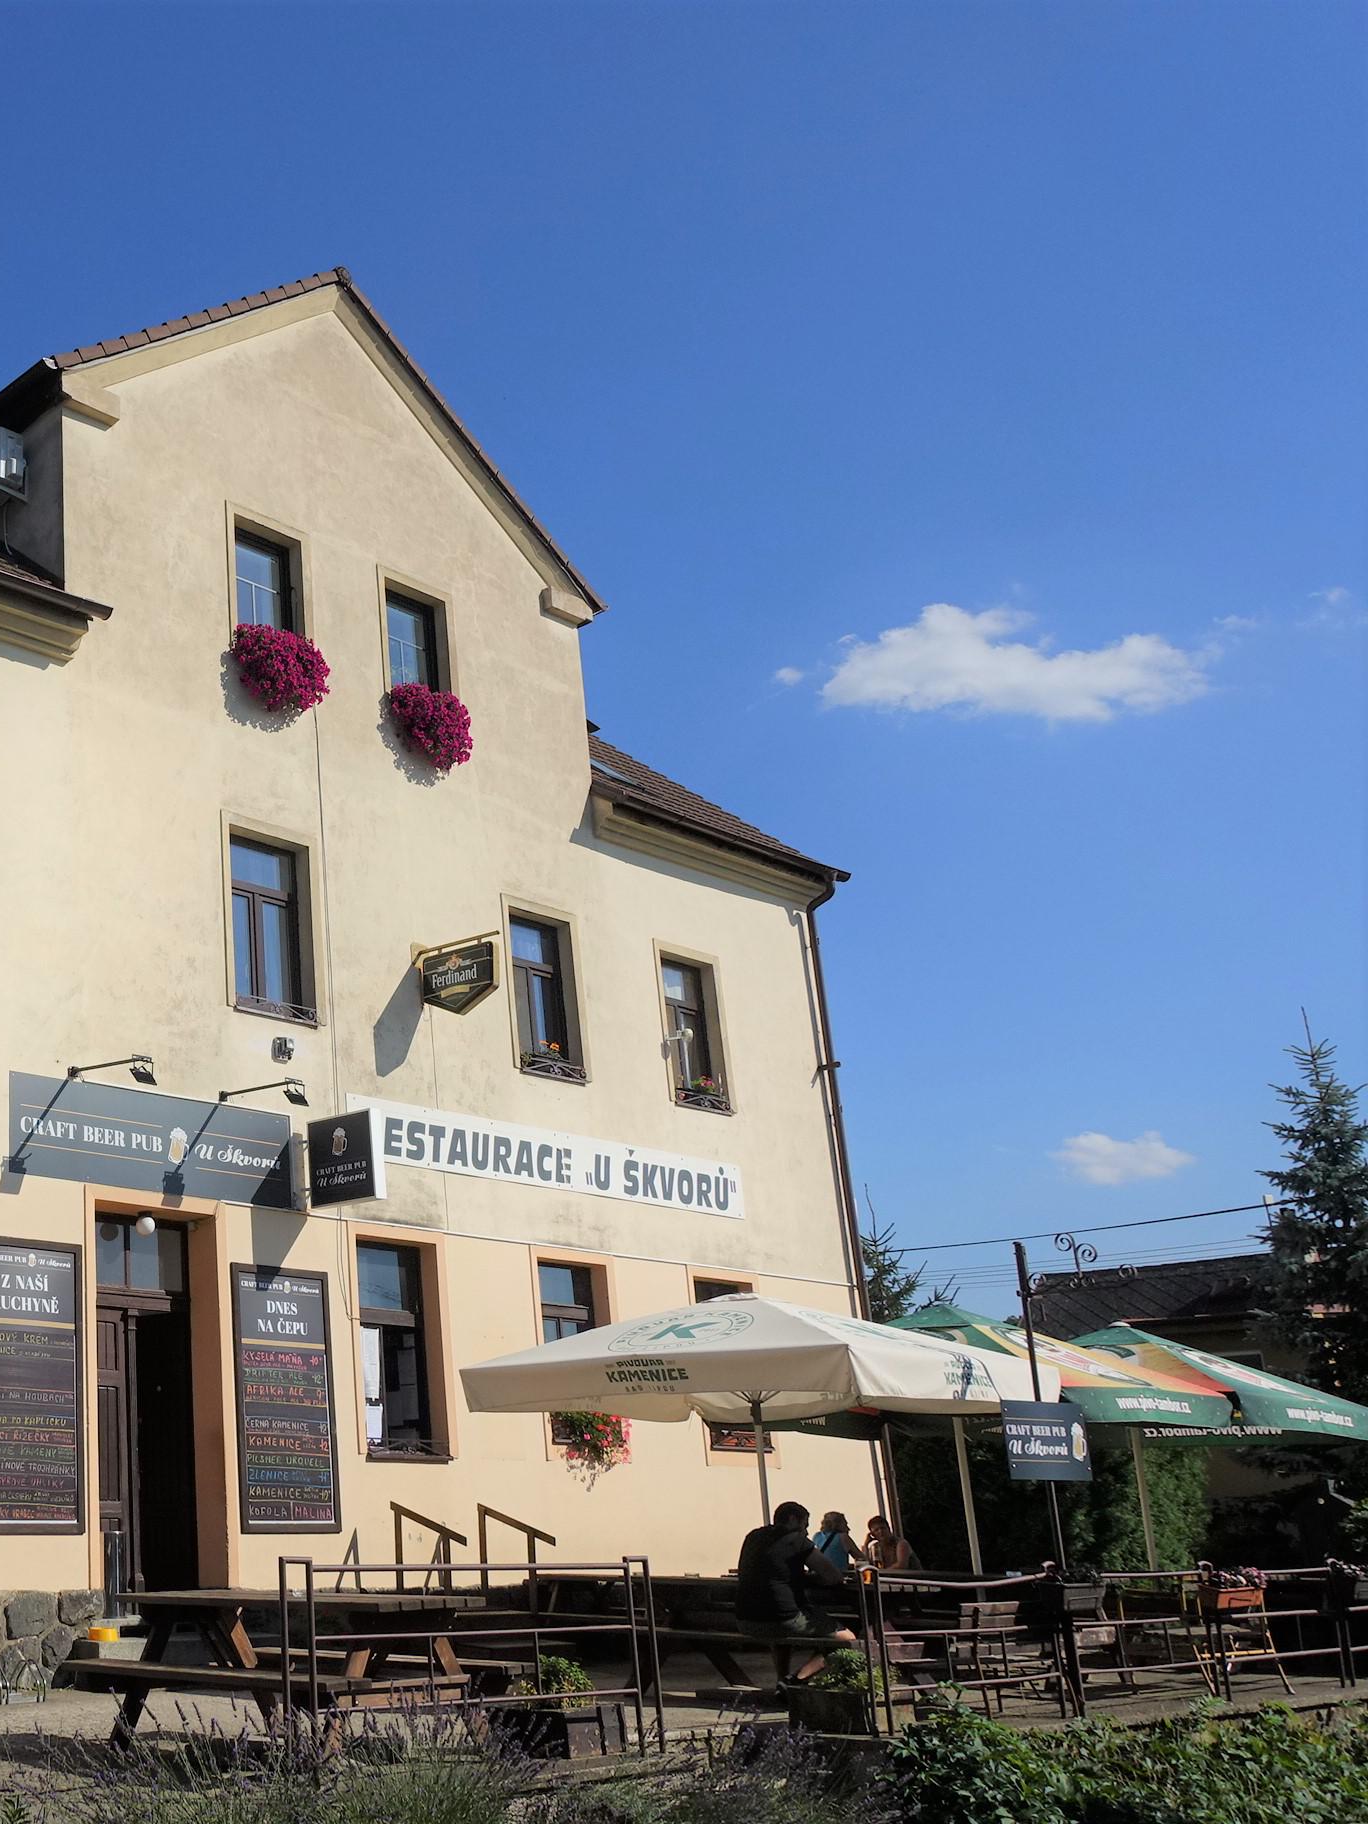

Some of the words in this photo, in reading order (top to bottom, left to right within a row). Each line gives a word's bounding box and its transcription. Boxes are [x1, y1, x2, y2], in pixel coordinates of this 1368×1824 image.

[432, 963, 478, 989] Ferdinand
[20, 1116, 78, 1140] CRAFT
[83, 1125, 125, 1147] BEER
[131, 1132, 163, 1152] PUB
[194, 1143, 214, 1160] U
[383, 1116, 571, 1184] ESTAURACE
[1, 1273, 11, 1289] Z
[15, 1274, 49, 1292] NAŠÍ
[266, 1300, 298, 1316] DNES
[257, 1319, 274, 1332] NA
[277, 1318, 308, 1336] ČEPU
[606, 1368, 689, 1383] KAMENICE
[1006, 1424, 1031, 1436] CRAFT
[1032, 1425, 1052, 1437] BEER
[1052, 1426, 1066, 1437] PUB
[1008, 1440, 1022, 1455] U
